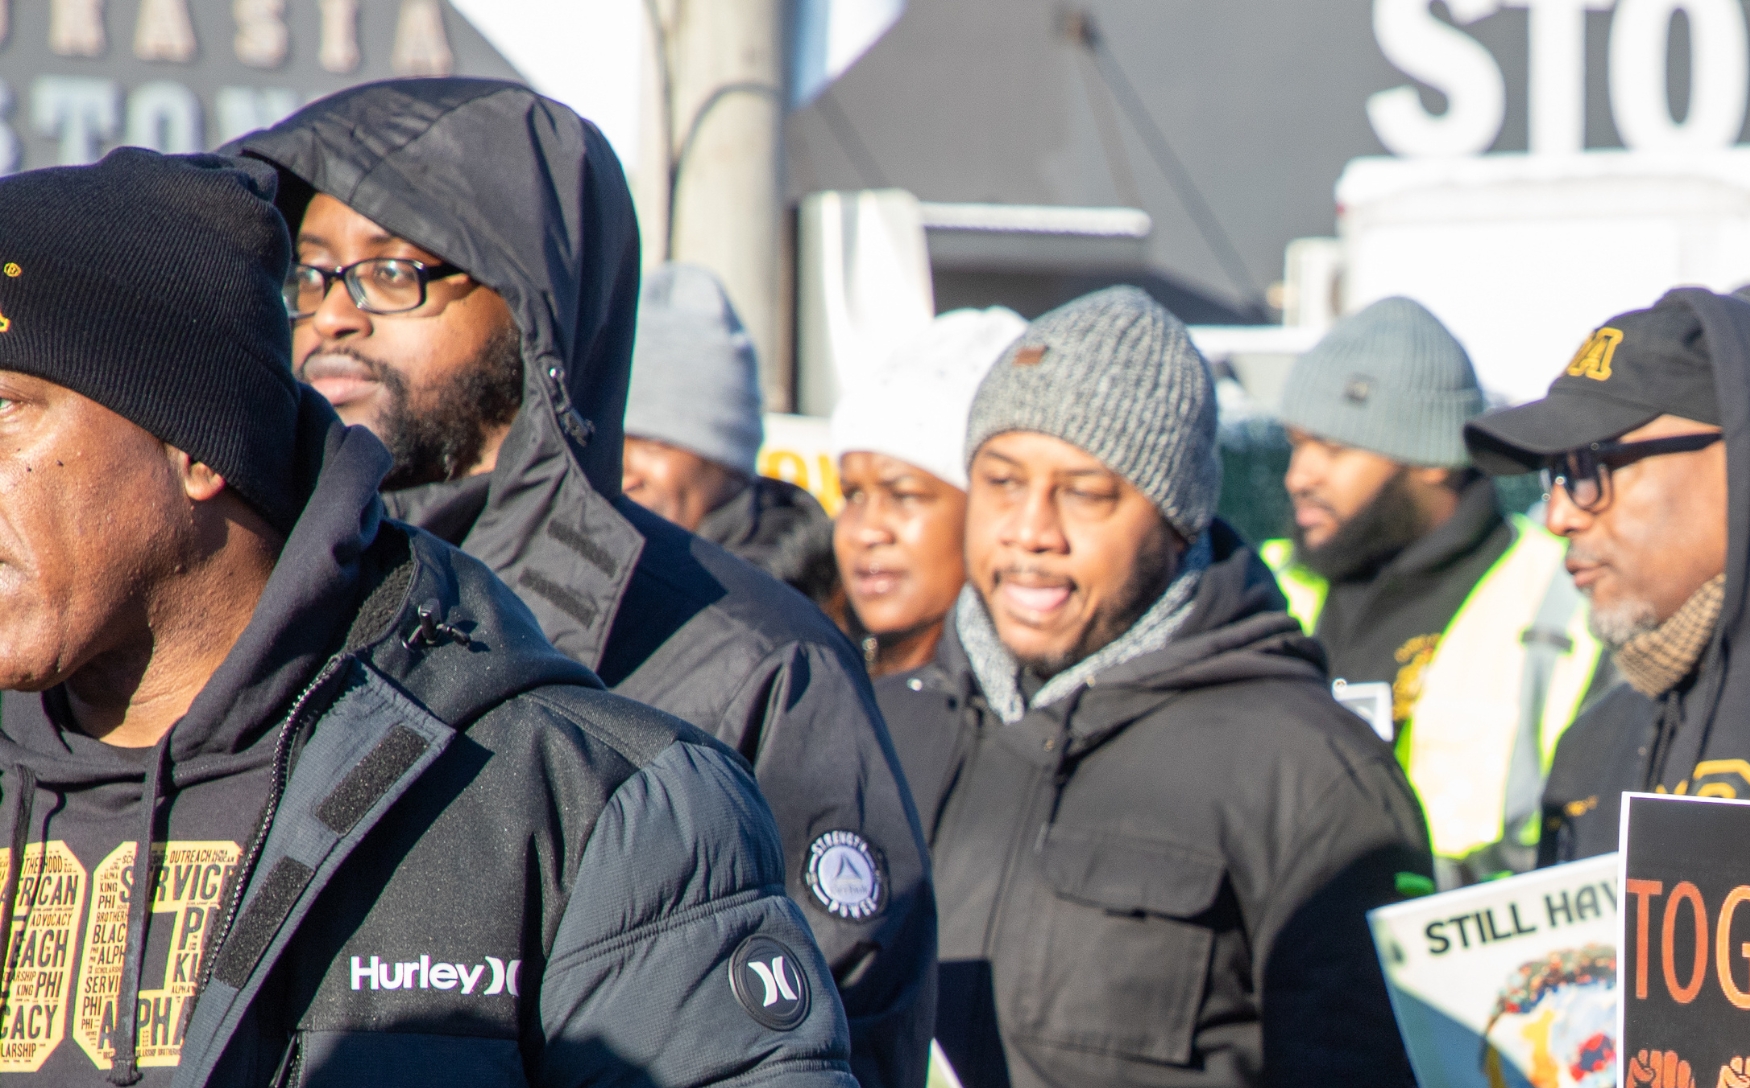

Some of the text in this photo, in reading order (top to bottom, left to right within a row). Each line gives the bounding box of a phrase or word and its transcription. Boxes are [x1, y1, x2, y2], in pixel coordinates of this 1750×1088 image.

[170, 850, 212, 864] OUTREACH
[99, 882, 118, 893] KING
[97, 895, 116, 909] PHI
[29, 912, 73, 928] ADVOCACY
[92, 923, 126, 945] BLAC
[1424, 903, 1537, 954] STILL
[350, 954, 485, 995] Hurley
[16, 984, 34, 996] KING
[34, 971, 63, 998] PHI
[82, 996, 102, 1016] PHI
[81, 1019, 93, 1030] PHI
